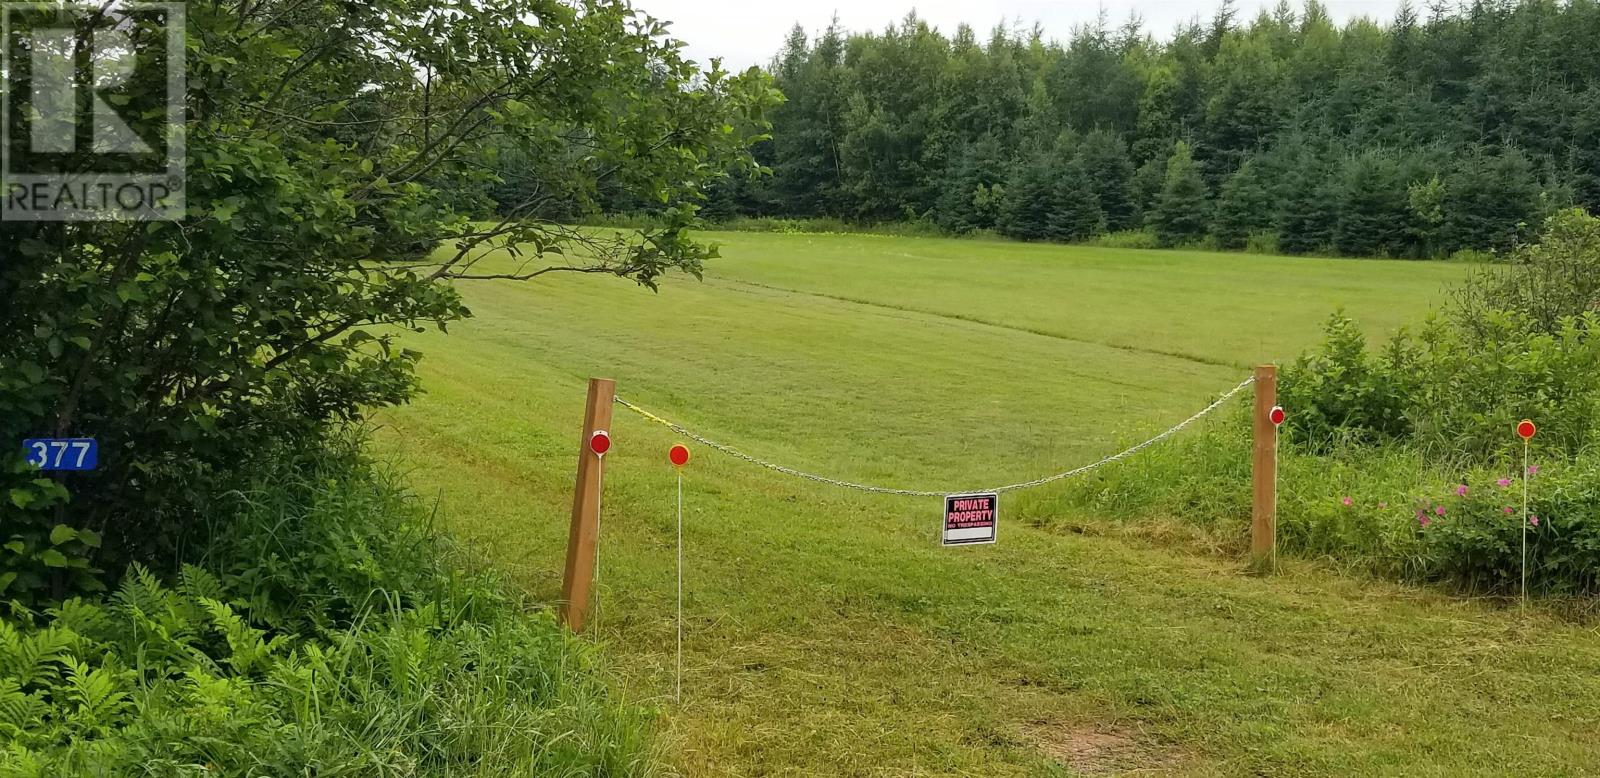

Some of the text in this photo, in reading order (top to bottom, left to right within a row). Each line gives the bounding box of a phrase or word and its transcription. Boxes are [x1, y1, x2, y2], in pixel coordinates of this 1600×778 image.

[29, 441, 90, 468] 377
[953, 499, 989, 511] PRIVATE
[948, 510, 993, 522] PROPERTY
